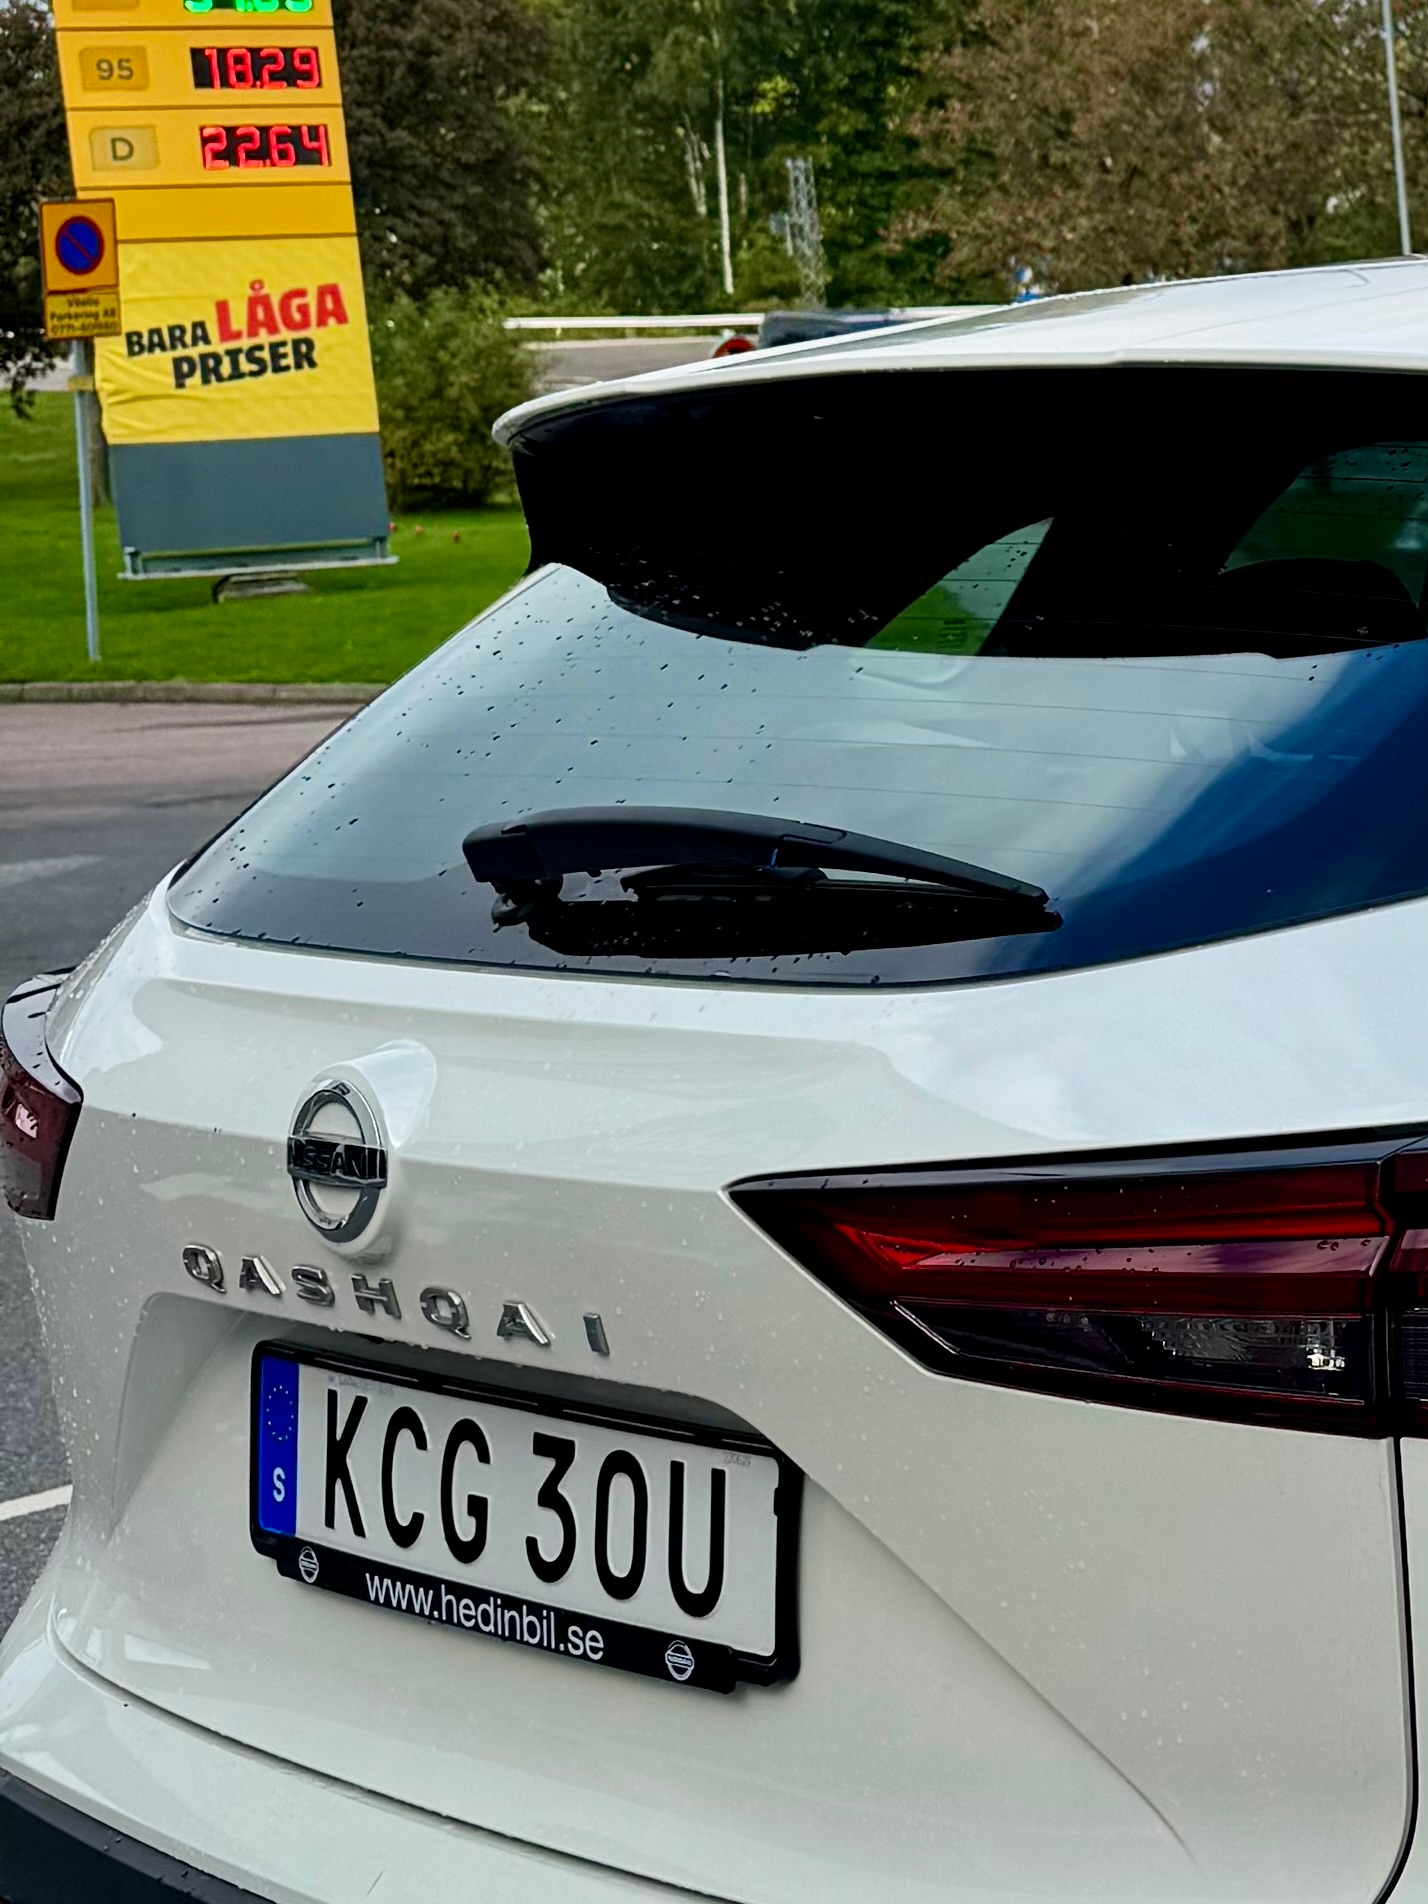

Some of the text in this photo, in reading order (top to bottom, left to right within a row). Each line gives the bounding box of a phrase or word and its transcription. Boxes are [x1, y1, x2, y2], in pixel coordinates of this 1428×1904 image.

[96, 58, 134, 80] 95
[110, 137, 134, 162] D
[125, 279, 349, 358] BARA LÅGA
[172, 337, 318, 389] PRISER
[182, 1243, 610, 1356] QASHQAI
[272, 1388, 726, 1617] S KCG 30U
[365, 1572, 605, 1661] www.hedinbil.se
